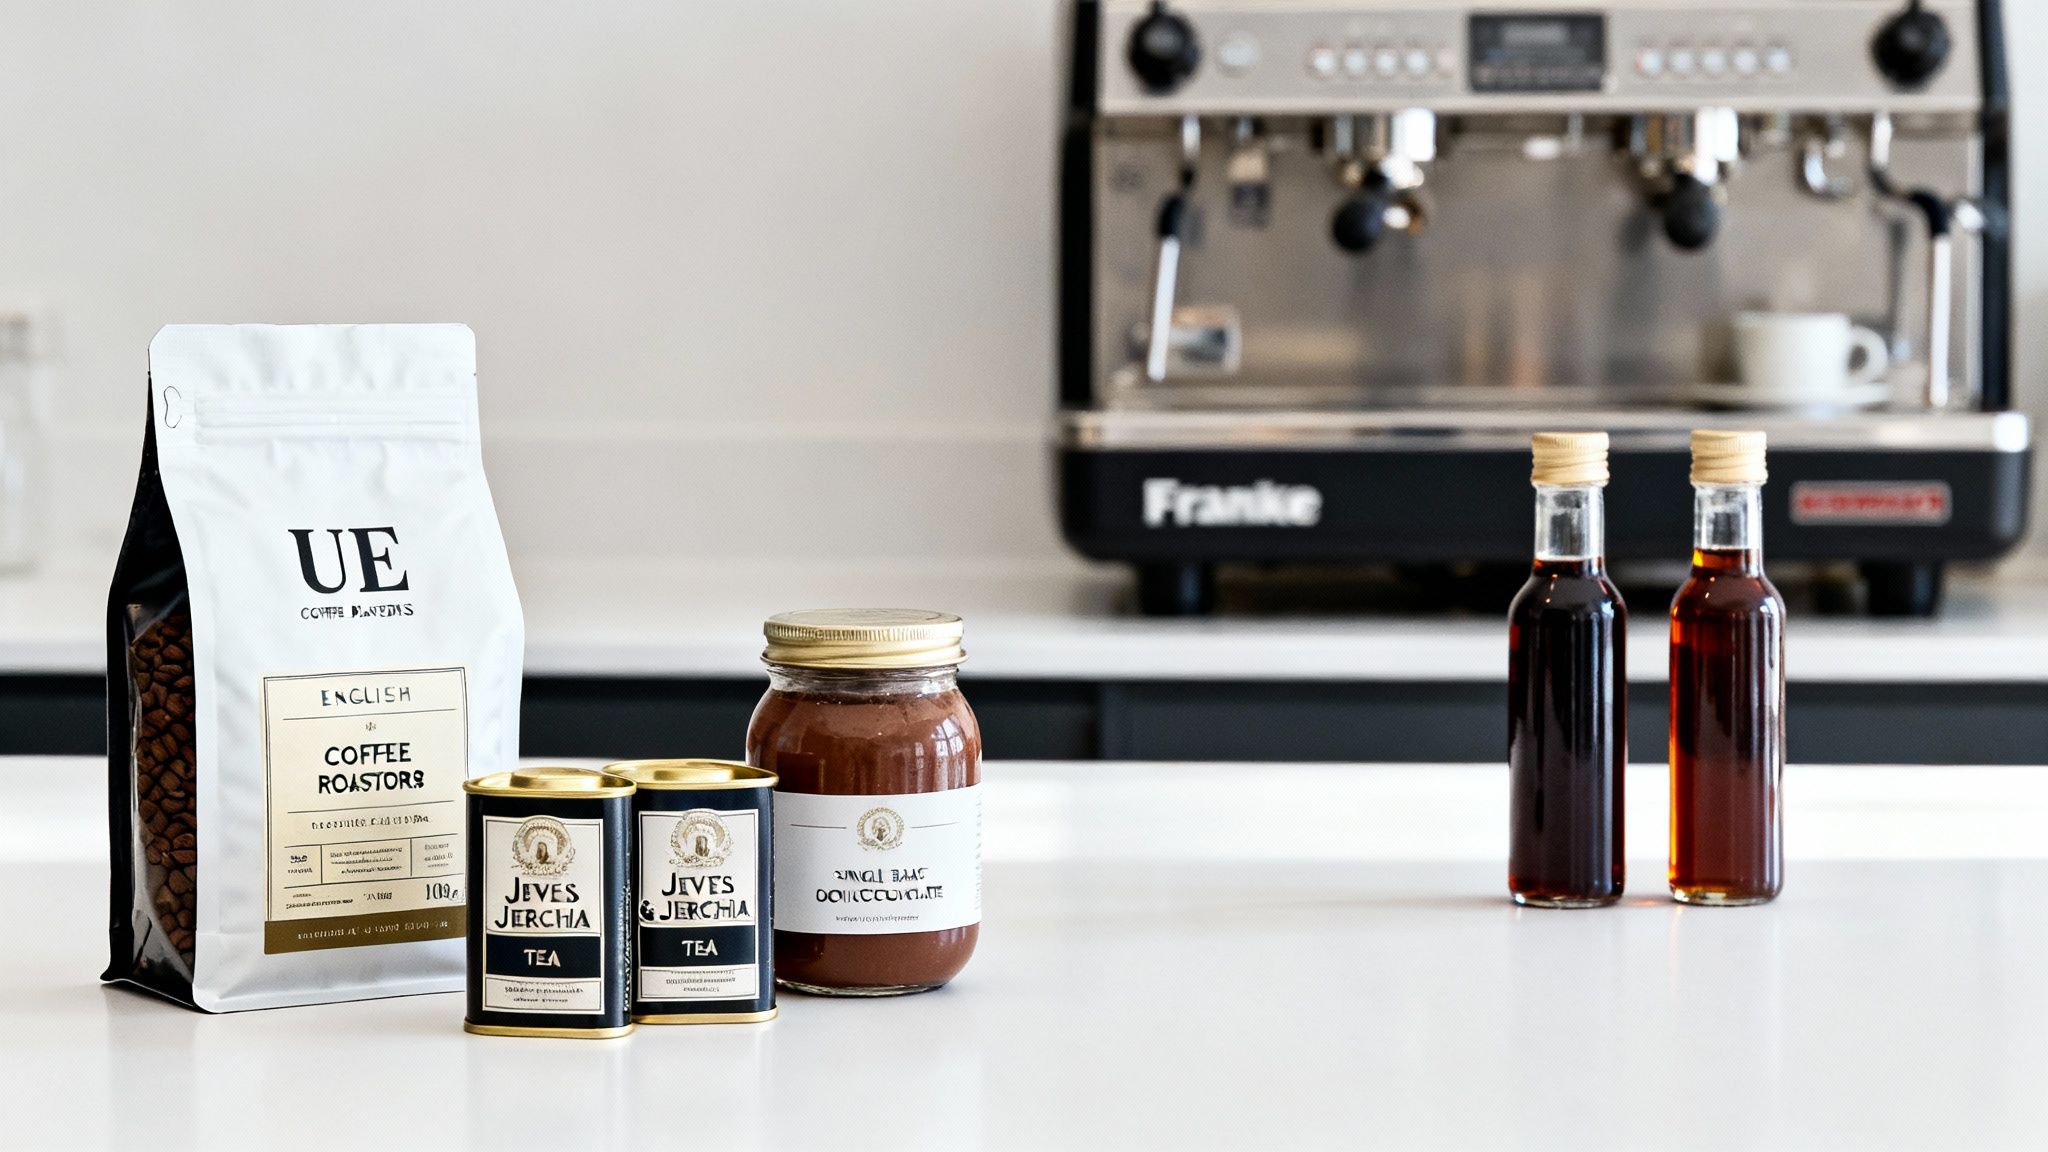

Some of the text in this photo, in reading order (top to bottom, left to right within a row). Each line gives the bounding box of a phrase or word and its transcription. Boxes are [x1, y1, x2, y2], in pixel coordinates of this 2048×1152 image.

[1143, 478, 1322, 527] Franke
[287, 526, 409, 594] UE
[321, 686, 411, 707] ENGLISH
[324, 742, 412, 766] COFFEE
[523, 948, 561, 968] TEA
[681, 938, 719, 957] TEA
